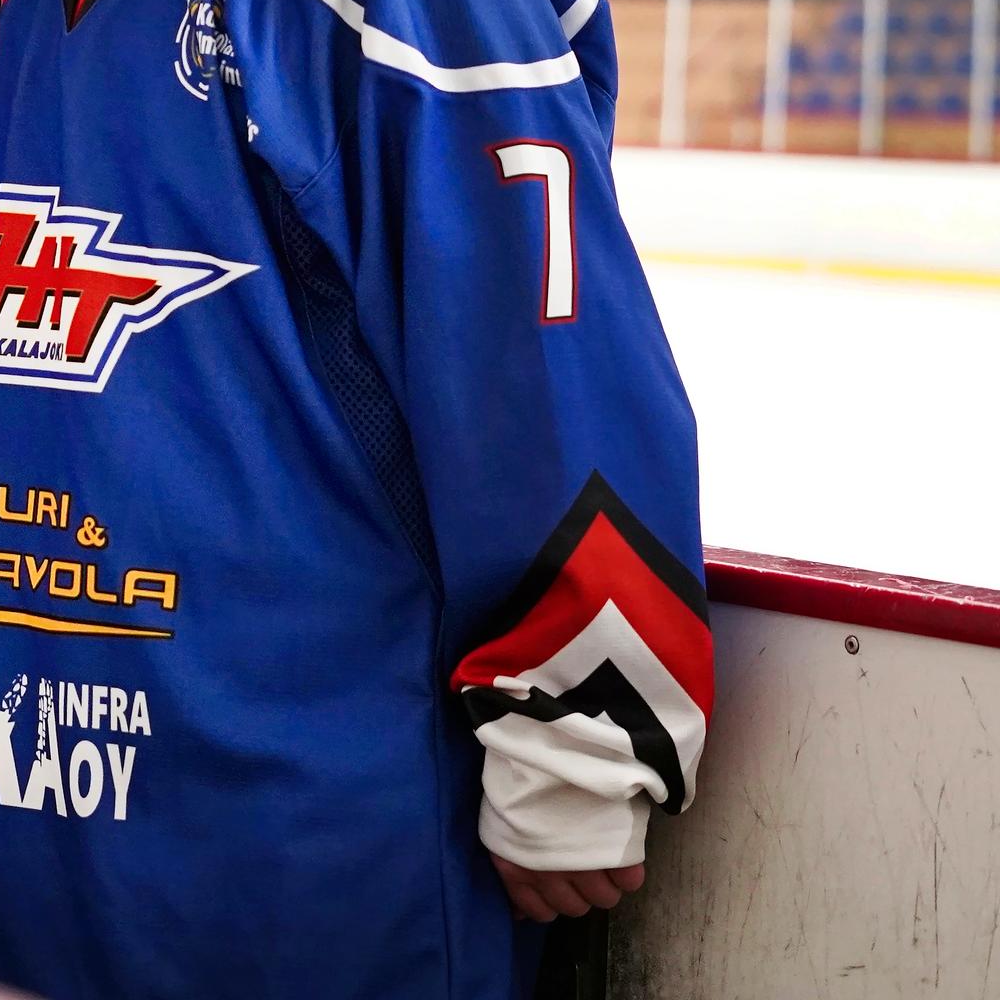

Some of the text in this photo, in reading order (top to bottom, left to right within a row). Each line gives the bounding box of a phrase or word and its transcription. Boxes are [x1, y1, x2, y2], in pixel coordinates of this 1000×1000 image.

[488, 139, 577, 324] 7
[77, 516, 108, 547] &
[59, 681, 151, 736] INFRA
[69, 740, 136, 821] OY
